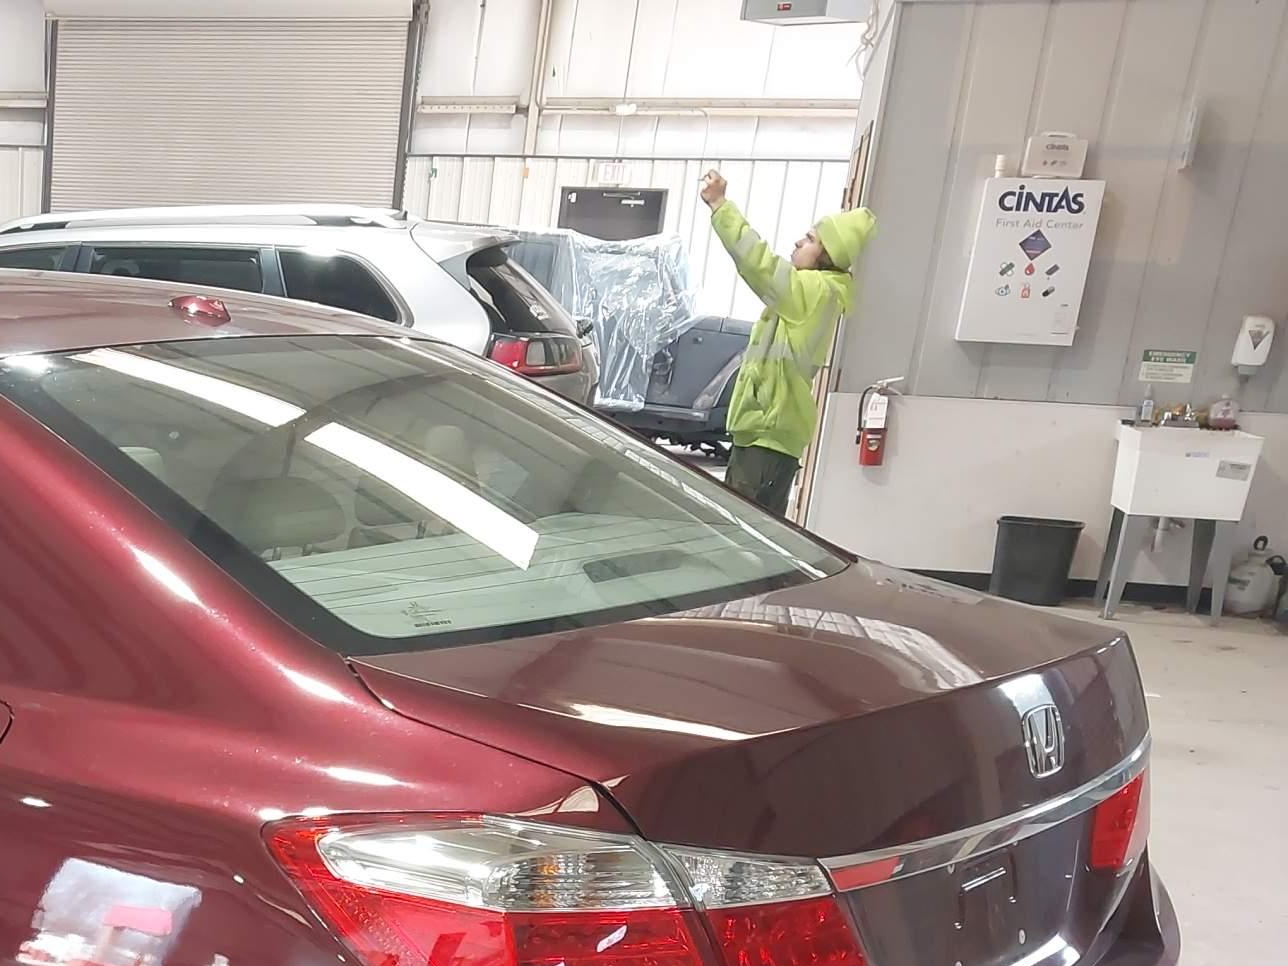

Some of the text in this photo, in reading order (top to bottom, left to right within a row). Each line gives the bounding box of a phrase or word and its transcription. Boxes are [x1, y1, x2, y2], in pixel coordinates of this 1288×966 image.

[996, 219, 1084, 229] First Aid Center
